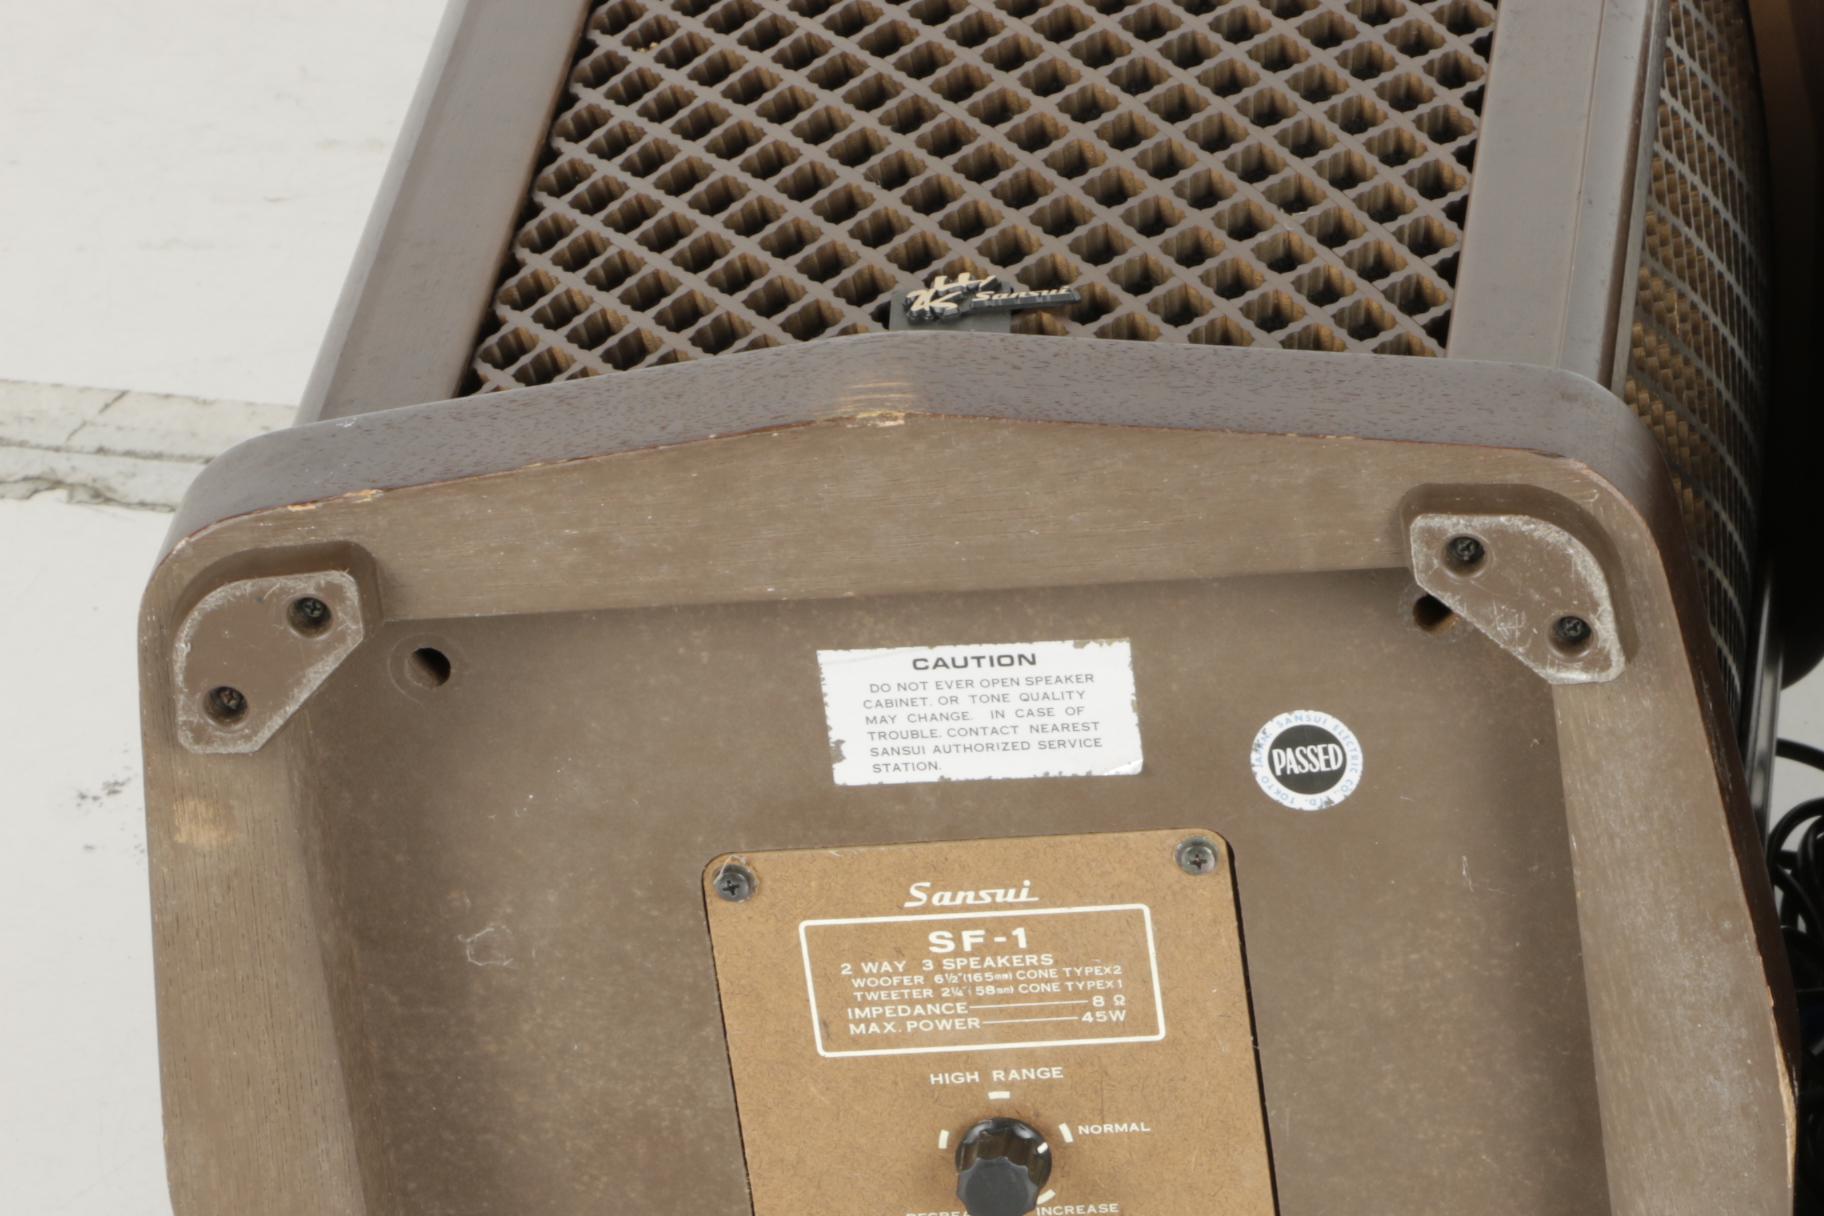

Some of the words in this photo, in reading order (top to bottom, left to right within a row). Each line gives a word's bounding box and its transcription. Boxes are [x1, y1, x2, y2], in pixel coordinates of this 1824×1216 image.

[912, 653, 1037, 670] CAUTION
[869, 683, 891, 693] DO
[897, 681, 928, 691] NOT
[935, 679, 975, 690] EVER
[979, 677, 1020, 688] OPEN
[1025, 674, 1094, 686] SPEAKER
[938, 696, 959, 705] OR
[968, 693, 1011, 704] TONE
[1019, 690, 1085, 702] QUALITY
[865, 715, 897, 725] MAY
[990, 709, 1006, 719] IN
[1015, 707, 1056, 718] CASE
[1065, 706, 1085, 716] OF
[946, 725, 1018, 737] CONTACT
[1030, 721, 1099, 733] NEAREST
[870, 745, 926, 757] SANSUI
[932, 741, 1031, 753] AUTHORIZED
[1038, 738, 1102, 750] SERVICE
[872, 761, 941, 773] STATION.
[1272, 743, 1343, 776] PASSED
[903, 880, 1039, 908] Sansui
[928, 928, 1028, 953] SF-1
[841, 963, 853, 975] 2
[861, 960, 907, 973] WAY
[922, 960, 934, 971] 3
[942, 954, 1054, 970] SPEAKERS
[852, 975, 924, 988] WOOFER
[1016, 968, 1058, 980] CONE
[853, 988, 934, 1001] TWEETER
[1018, 982, 1061, 994] CONE
[847, 1003, 968, 1019] IMPEDANCE
[1092, 995, 1104, 1007] 8
[849, 1022, 901, 1035] MAX.
[906, 1018, 981, 1032] POWER
[1081, 1010, 1126, 1022] 45W
[930, 1072, 980, 1084] HIGH
[992, 1066, 1064, 1081] RANGE
[1078, 1122, 1151, 1135] NORMAL
[1037, 1203, 1120, 1216] INCREASE
